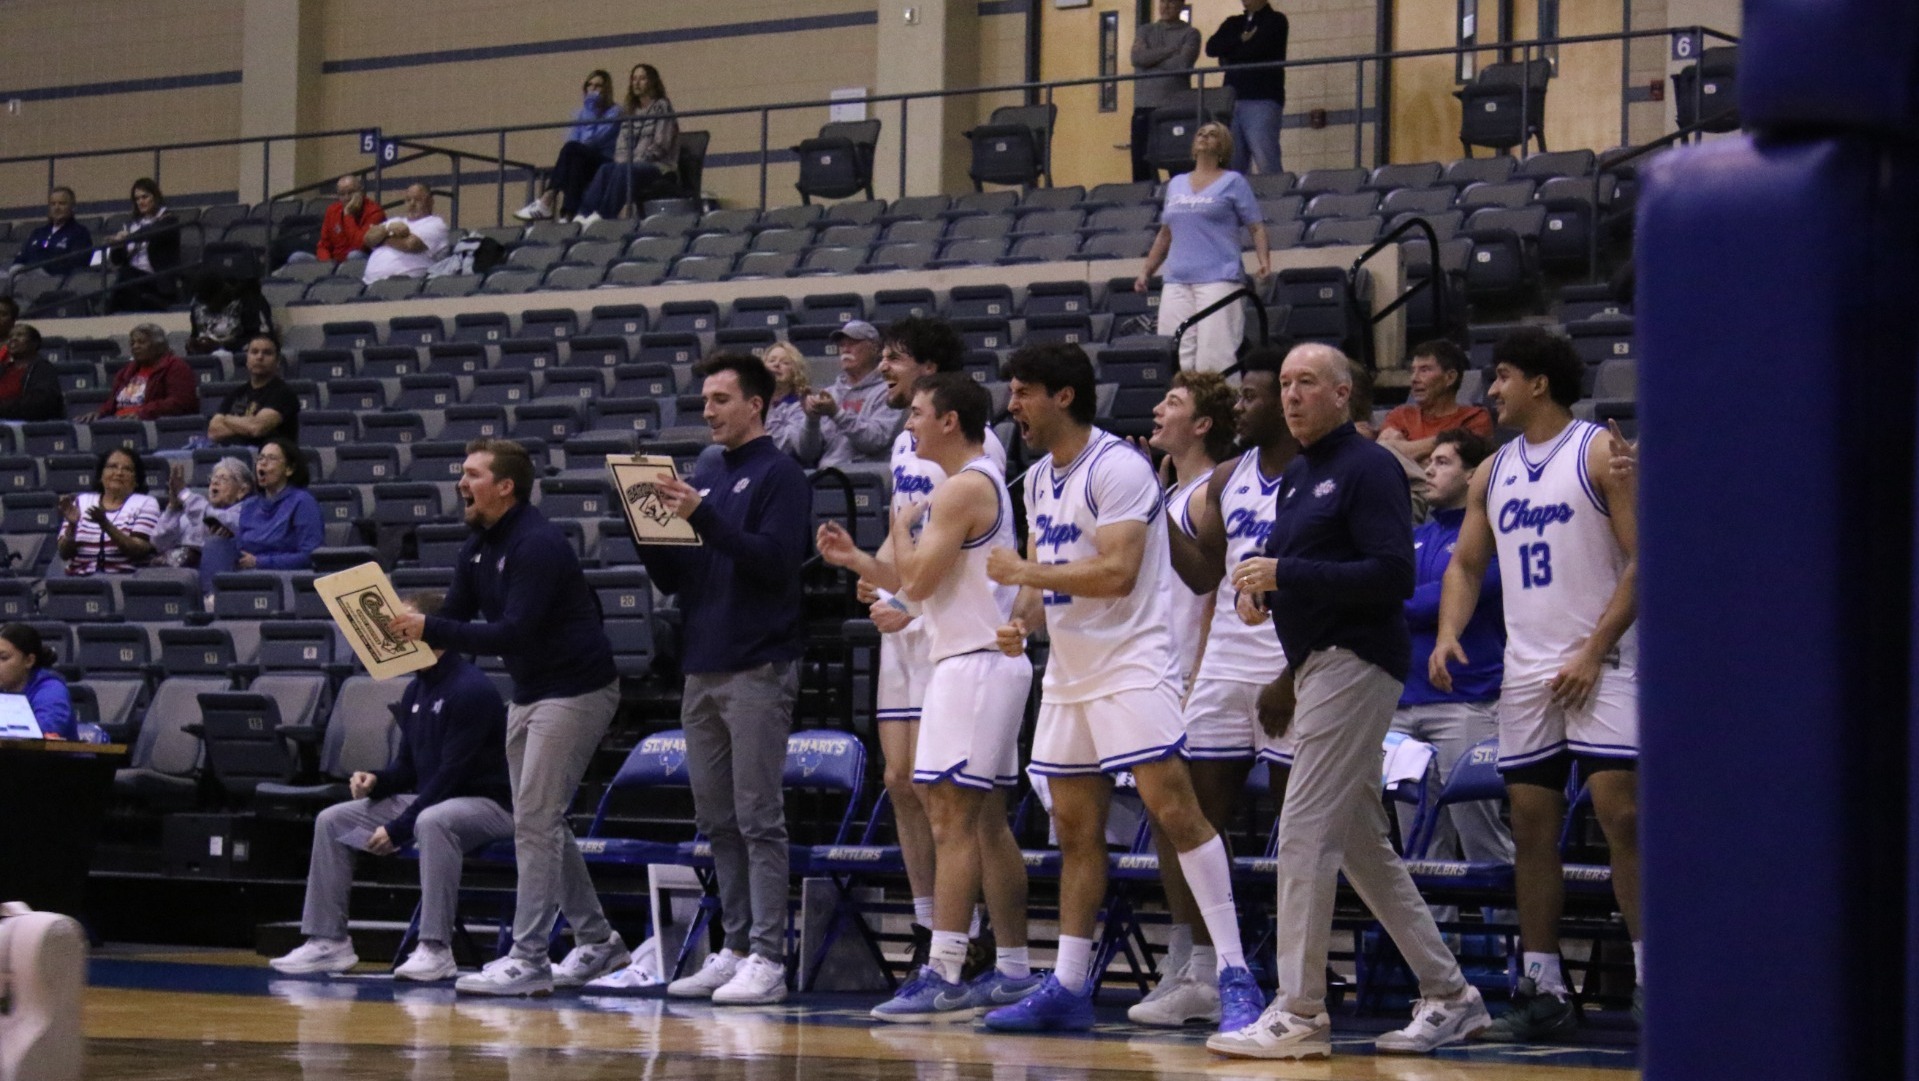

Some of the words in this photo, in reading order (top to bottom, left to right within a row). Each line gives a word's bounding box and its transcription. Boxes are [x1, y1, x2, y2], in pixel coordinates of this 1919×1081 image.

[1677, 37, 1691, 57] 6
[364, 135, 374, 151] 5
[384, 144, 395, 160] 6
[1498, 498, 1574, 536] Chaps
[1519, 541, 1552, 589] 13
